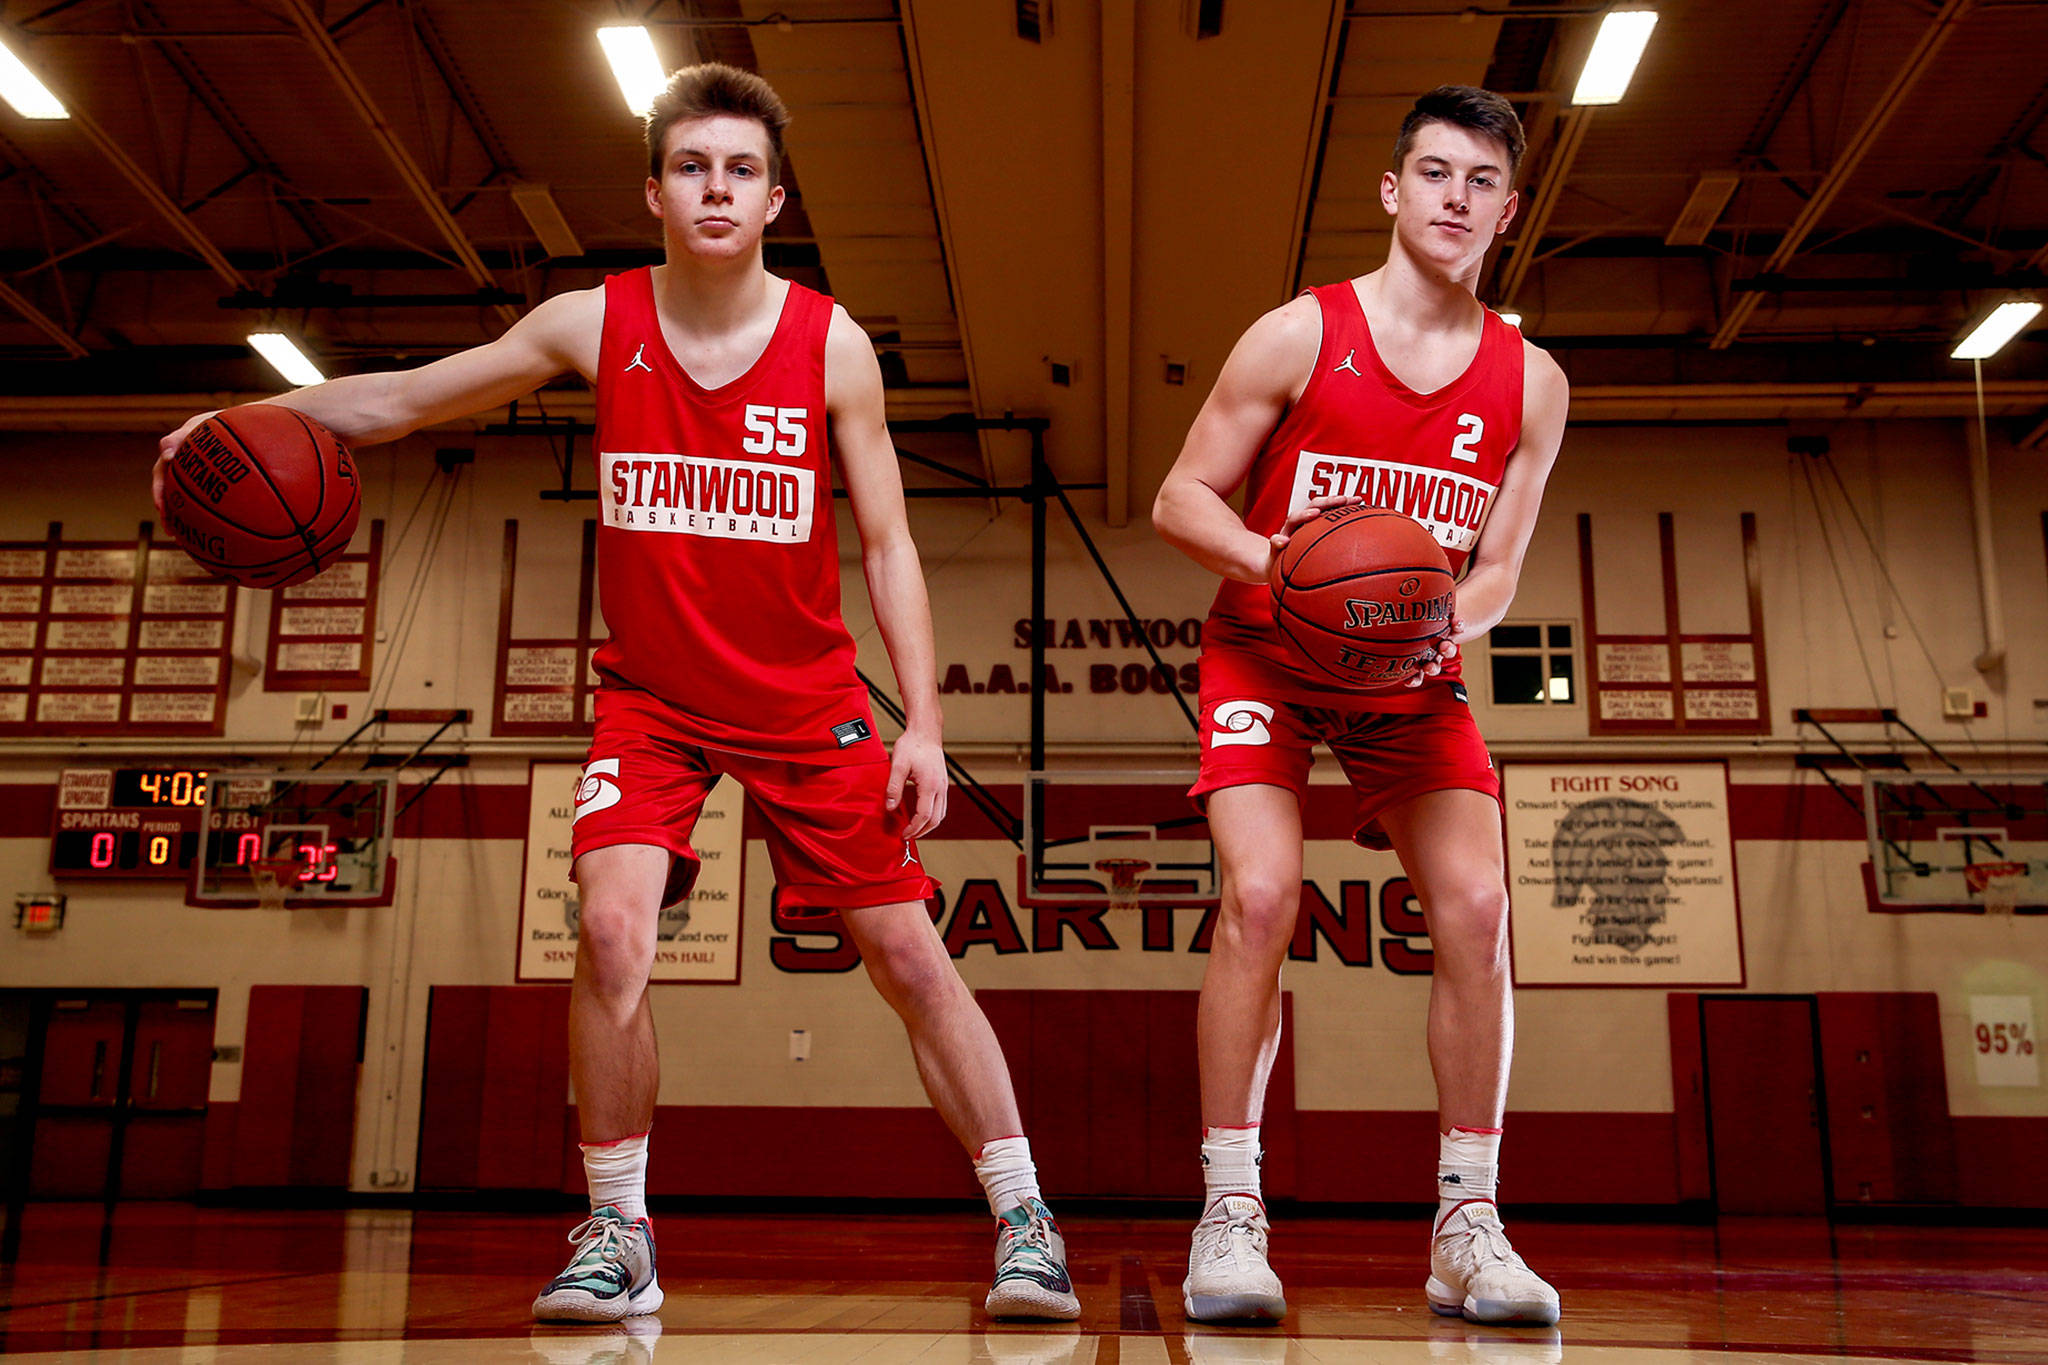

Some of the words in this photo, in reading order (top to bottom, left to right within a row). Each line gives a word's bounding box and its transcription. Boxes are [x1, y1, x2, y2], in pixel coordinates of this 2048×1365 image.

[743, 404, 807, 457] 55
[1451, 412, 1484, 463] 2
[612, 460, 799, 520] STANWOOD
[1309, 461, 1489, 531] STANWOOD
[614, 509, 797, 537] BASKETBALL
[1344, 591, 1453, 630] SPALDING
[1551, 776, 1612, 793] FIGHT
[1619, 775, 1679, 793] SONG
[1515, 800, 1558, 810] Onward
[61, 812, 140, 829] SPARTANS
[549, 808, 570, 819] ALL
[143, 821, 181, 832] PERIOD
[1524, 838, 1549, 848] Take
[90, 833, 116, 868] 0
[149, 837, 169, 865] 0
[1528, 858, 1550, 868] And
[1518, 875, 1561, 885] Onward
[698, 889, 729, 901] Pride
[532, 929, 564, 941] Brave
[679, 931, 700, 942] and
[704, 933, 729, 942] ever
[681, 952, 715, 964] HAIL!
[1572, 954, 1595, 965] And
[1597, 955, 1617, 965] win
[1619, 954, 1641, 965] this
[1644, 954, 1680, 968] game!
[1976, 1022, 2034, 1057] 95%
[1228, 1200, 1259, 1214] LEBRON
